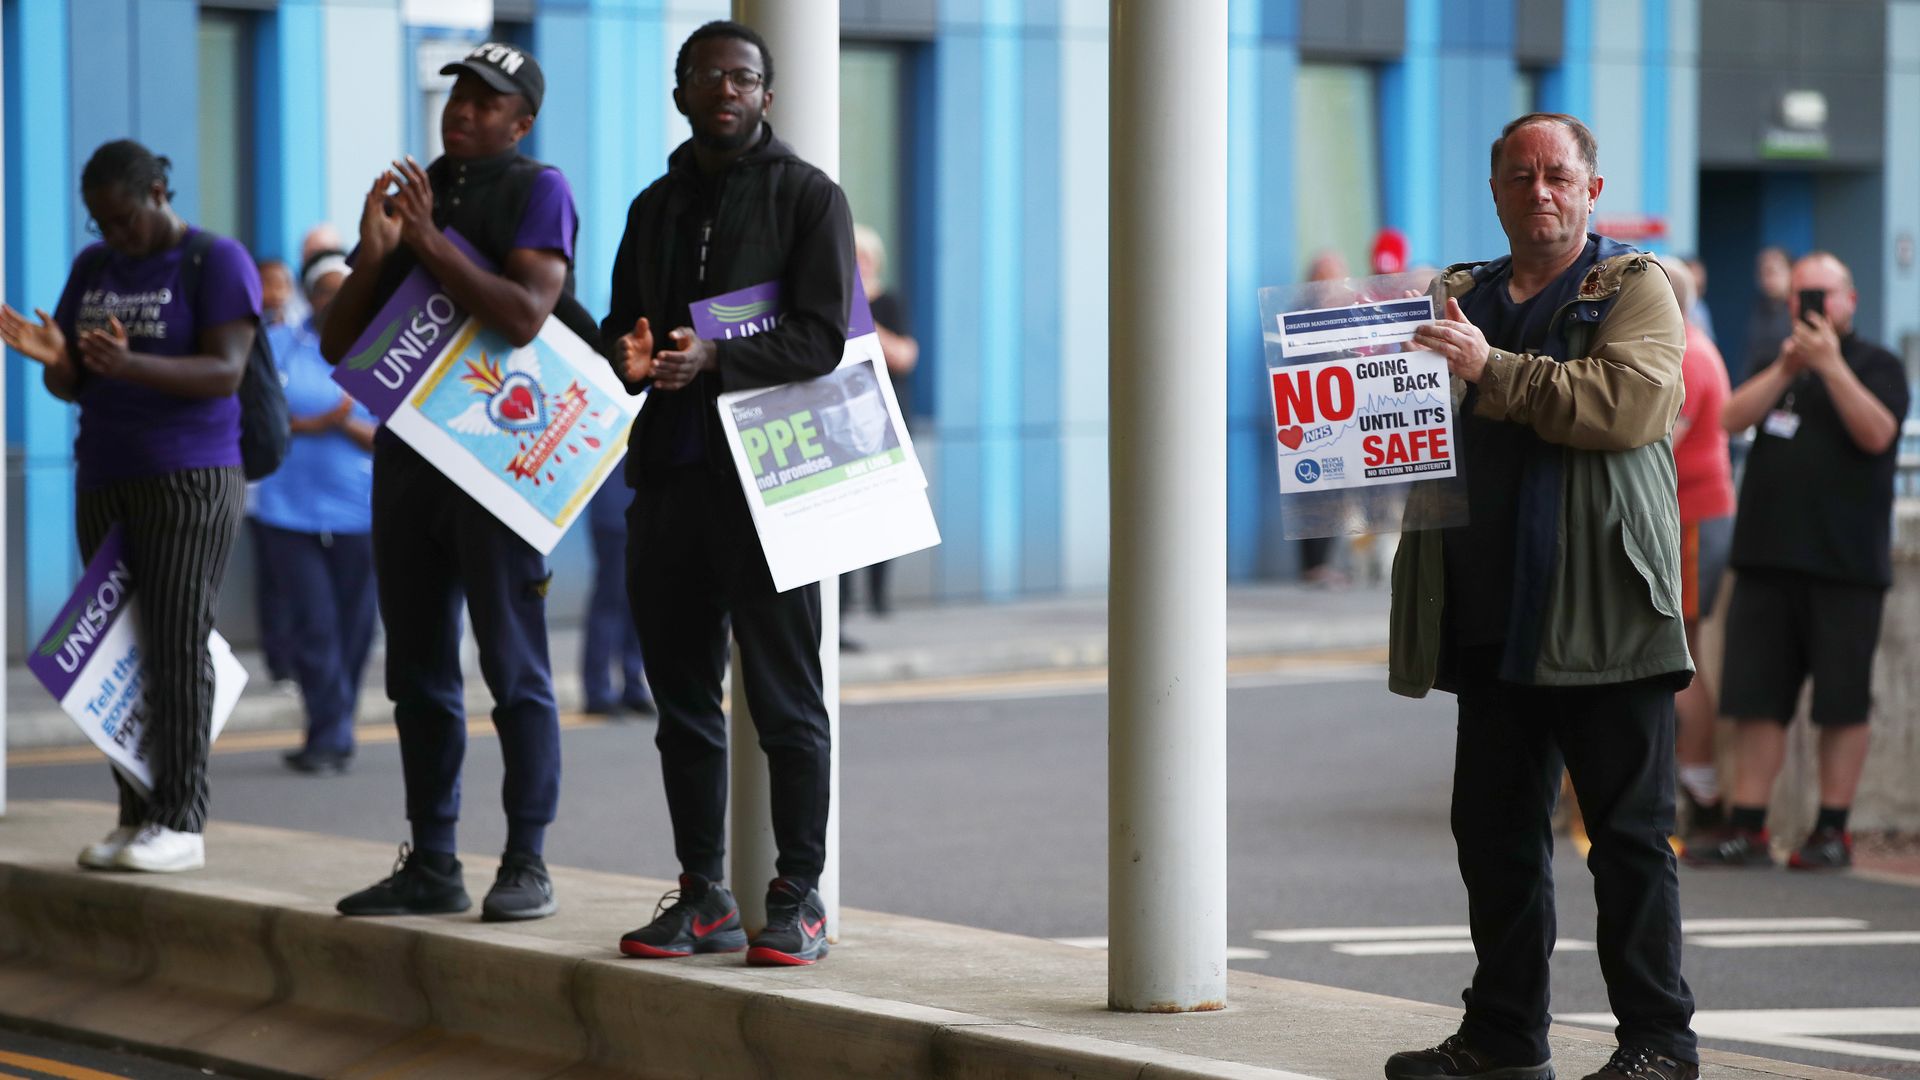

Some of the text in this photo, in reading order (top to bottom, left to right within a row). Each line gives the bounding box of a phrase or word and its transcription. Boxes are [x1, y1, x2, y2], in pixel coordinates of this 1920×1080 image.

[1286, 309, 1429, 330] GREATER MANCHESTER CORONAVIRUS ACTION GROUP
[373, 293, 455, 390] UNISO
[1356, 358, 1408, 380] GOING
[1393, 372, 1440, 393] BACK
[1273, 366, 1355, 426] NO
[1305, 425, 1331, 443] NHS
[1359, 407, 1446, 432] UNTIL IT'S
[739, 410, 824, 476] PPE
[1362, 428, 1450, 467] SAFE
[757, 456, 833, 490] not promises
[1367, 462, 1448, 477] NO RETURN TO AUSTERITY
[55, 560, 131, 674] UNISON
[84, 645, 139, 716] Tell the
